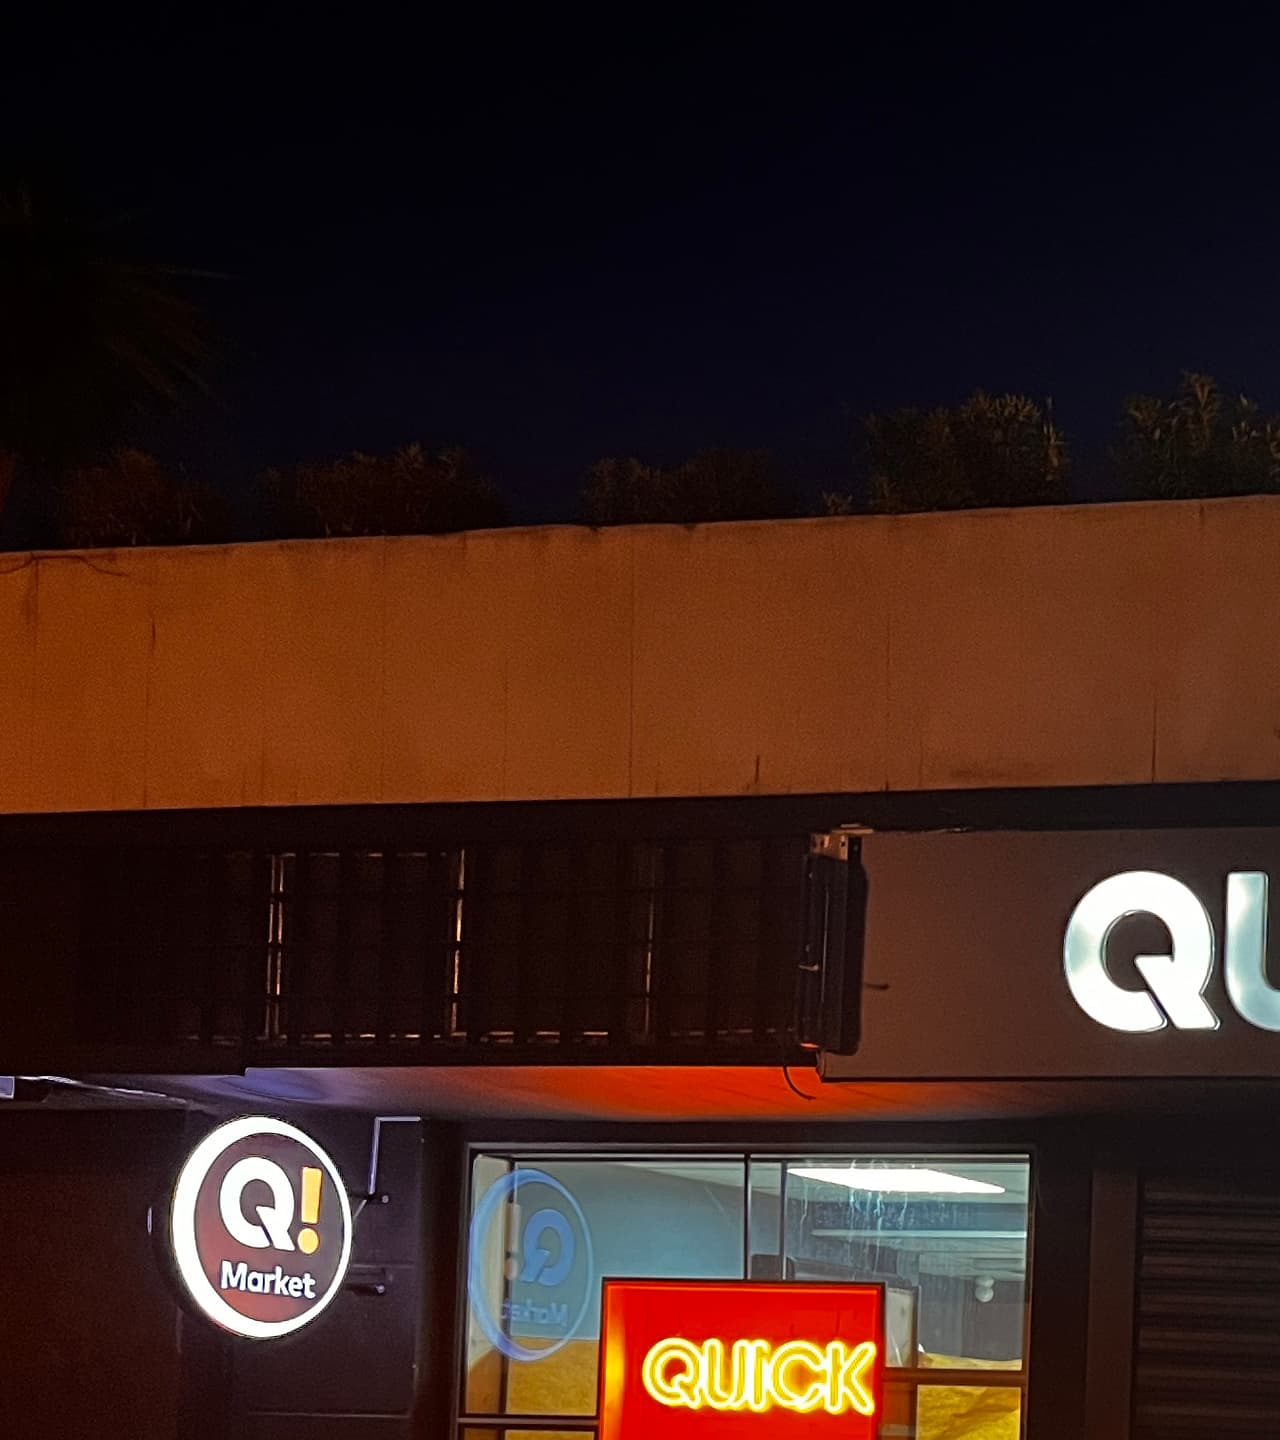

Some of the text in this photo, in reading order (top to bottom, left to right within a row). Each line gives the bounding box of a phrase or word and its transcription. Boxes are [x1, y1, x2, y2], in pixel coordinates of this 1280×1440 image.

[219, 1157, 322, 1254] Q!
[220, 1260, 317, 1299] Market
[642, 1337, 876, 1415] QUICK
